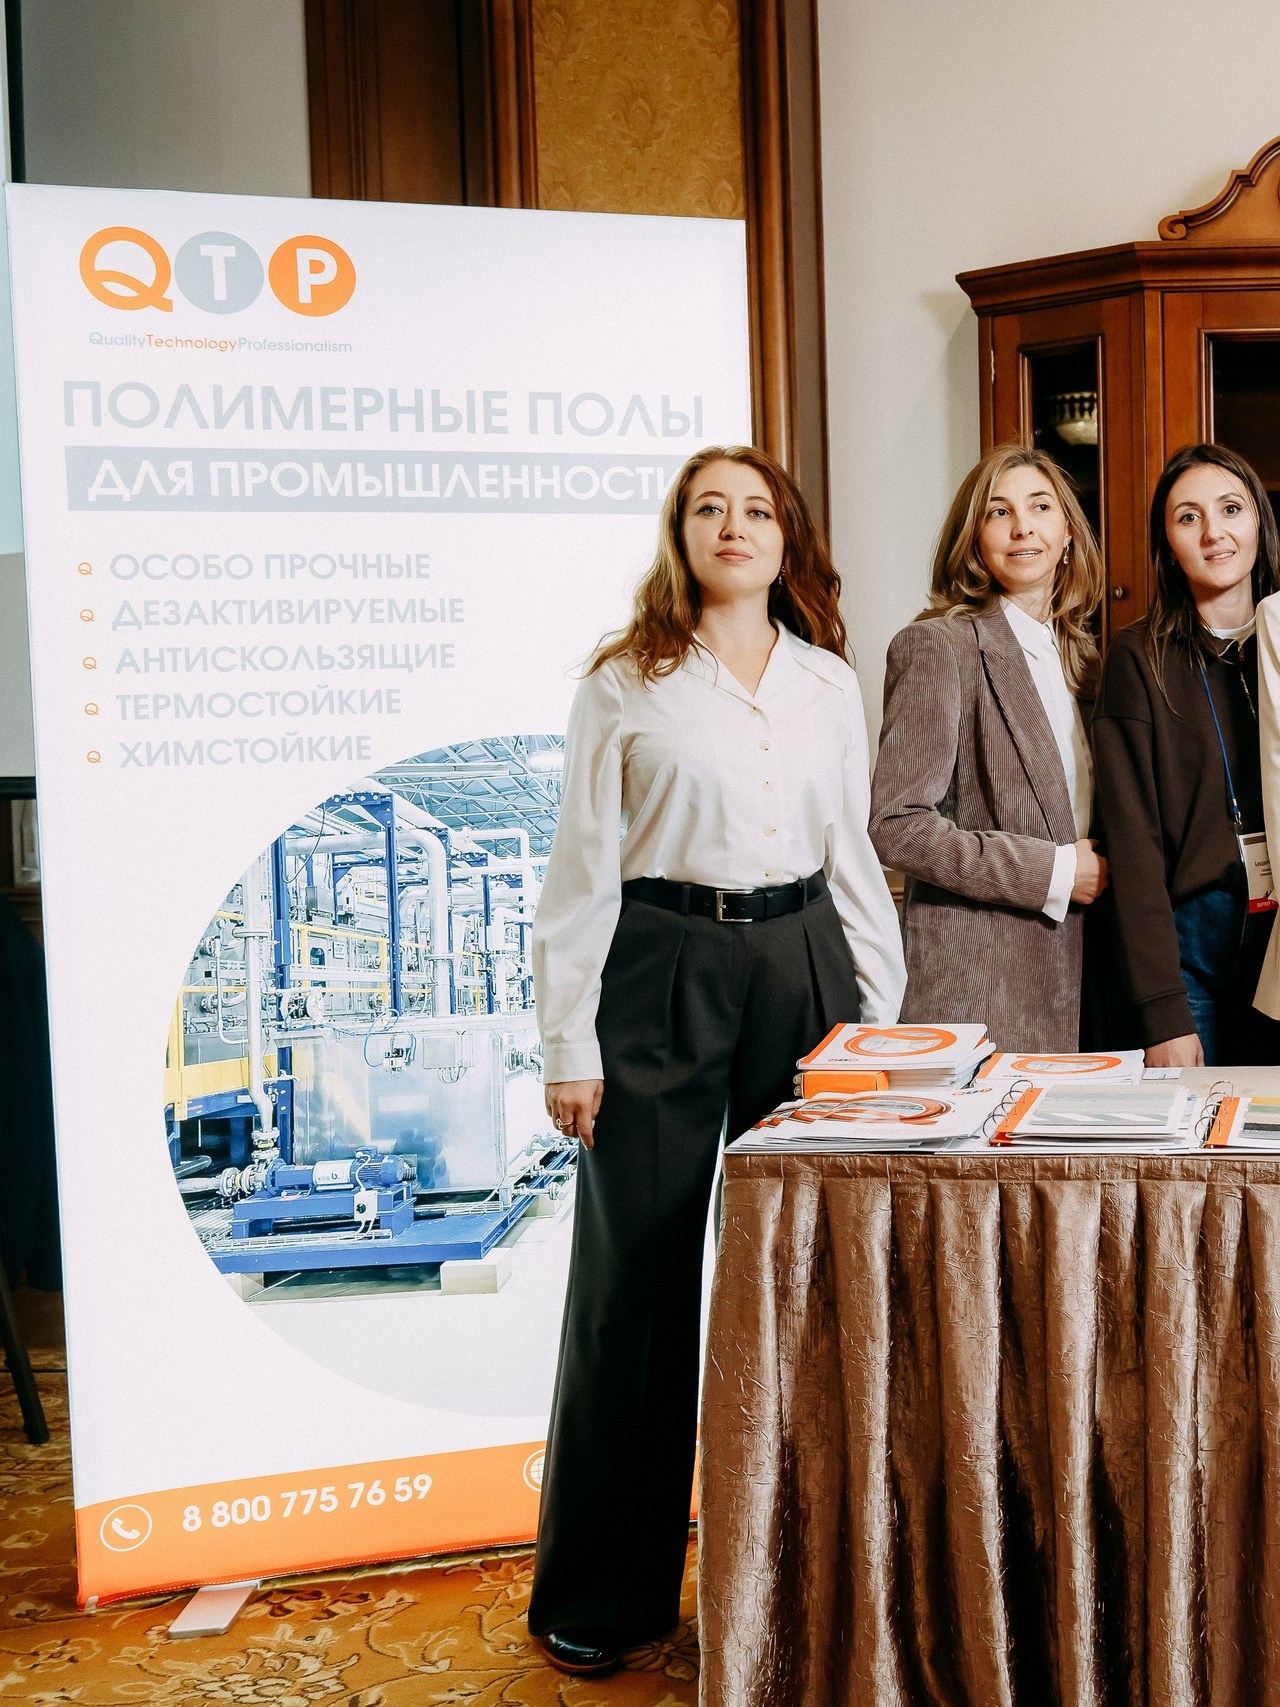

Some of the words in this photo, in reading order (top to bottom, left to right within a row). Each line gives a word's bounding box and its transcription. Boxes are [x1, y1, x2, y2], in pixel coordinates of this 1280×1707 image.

[79, 226, 356, 317] QTP
[64, 380, 508, 435] ПОЛИМЕРНЫЕ
[530, 391, 703, 438] ПОЛЫ
[88, 460, 194, 501] ДЛЯ
[110, 554, 253, 580] ОСОБО
[265, 553, 431, 579] ПРОЧНЫЕ
[112, 598, 464, 631] ДЕЗАКТИВИРУЕМЫЕ
[115, 643, 456, 674] АНТИСКОЛЬЗЯЩИЕ
[115, 684, 402, 720] ТЕРМОСТОЙКИЕ
[119, 731, 372, 768] ХИМСТОЙКИЕ
[182, 1504, 202, 1533] 8
[211, 1493, 272, 1529] 800
[280, 1485, 340, 1520] 775
[347, 1480, 387, 1510] 76
[394, 1473, 433, 1502] 59
